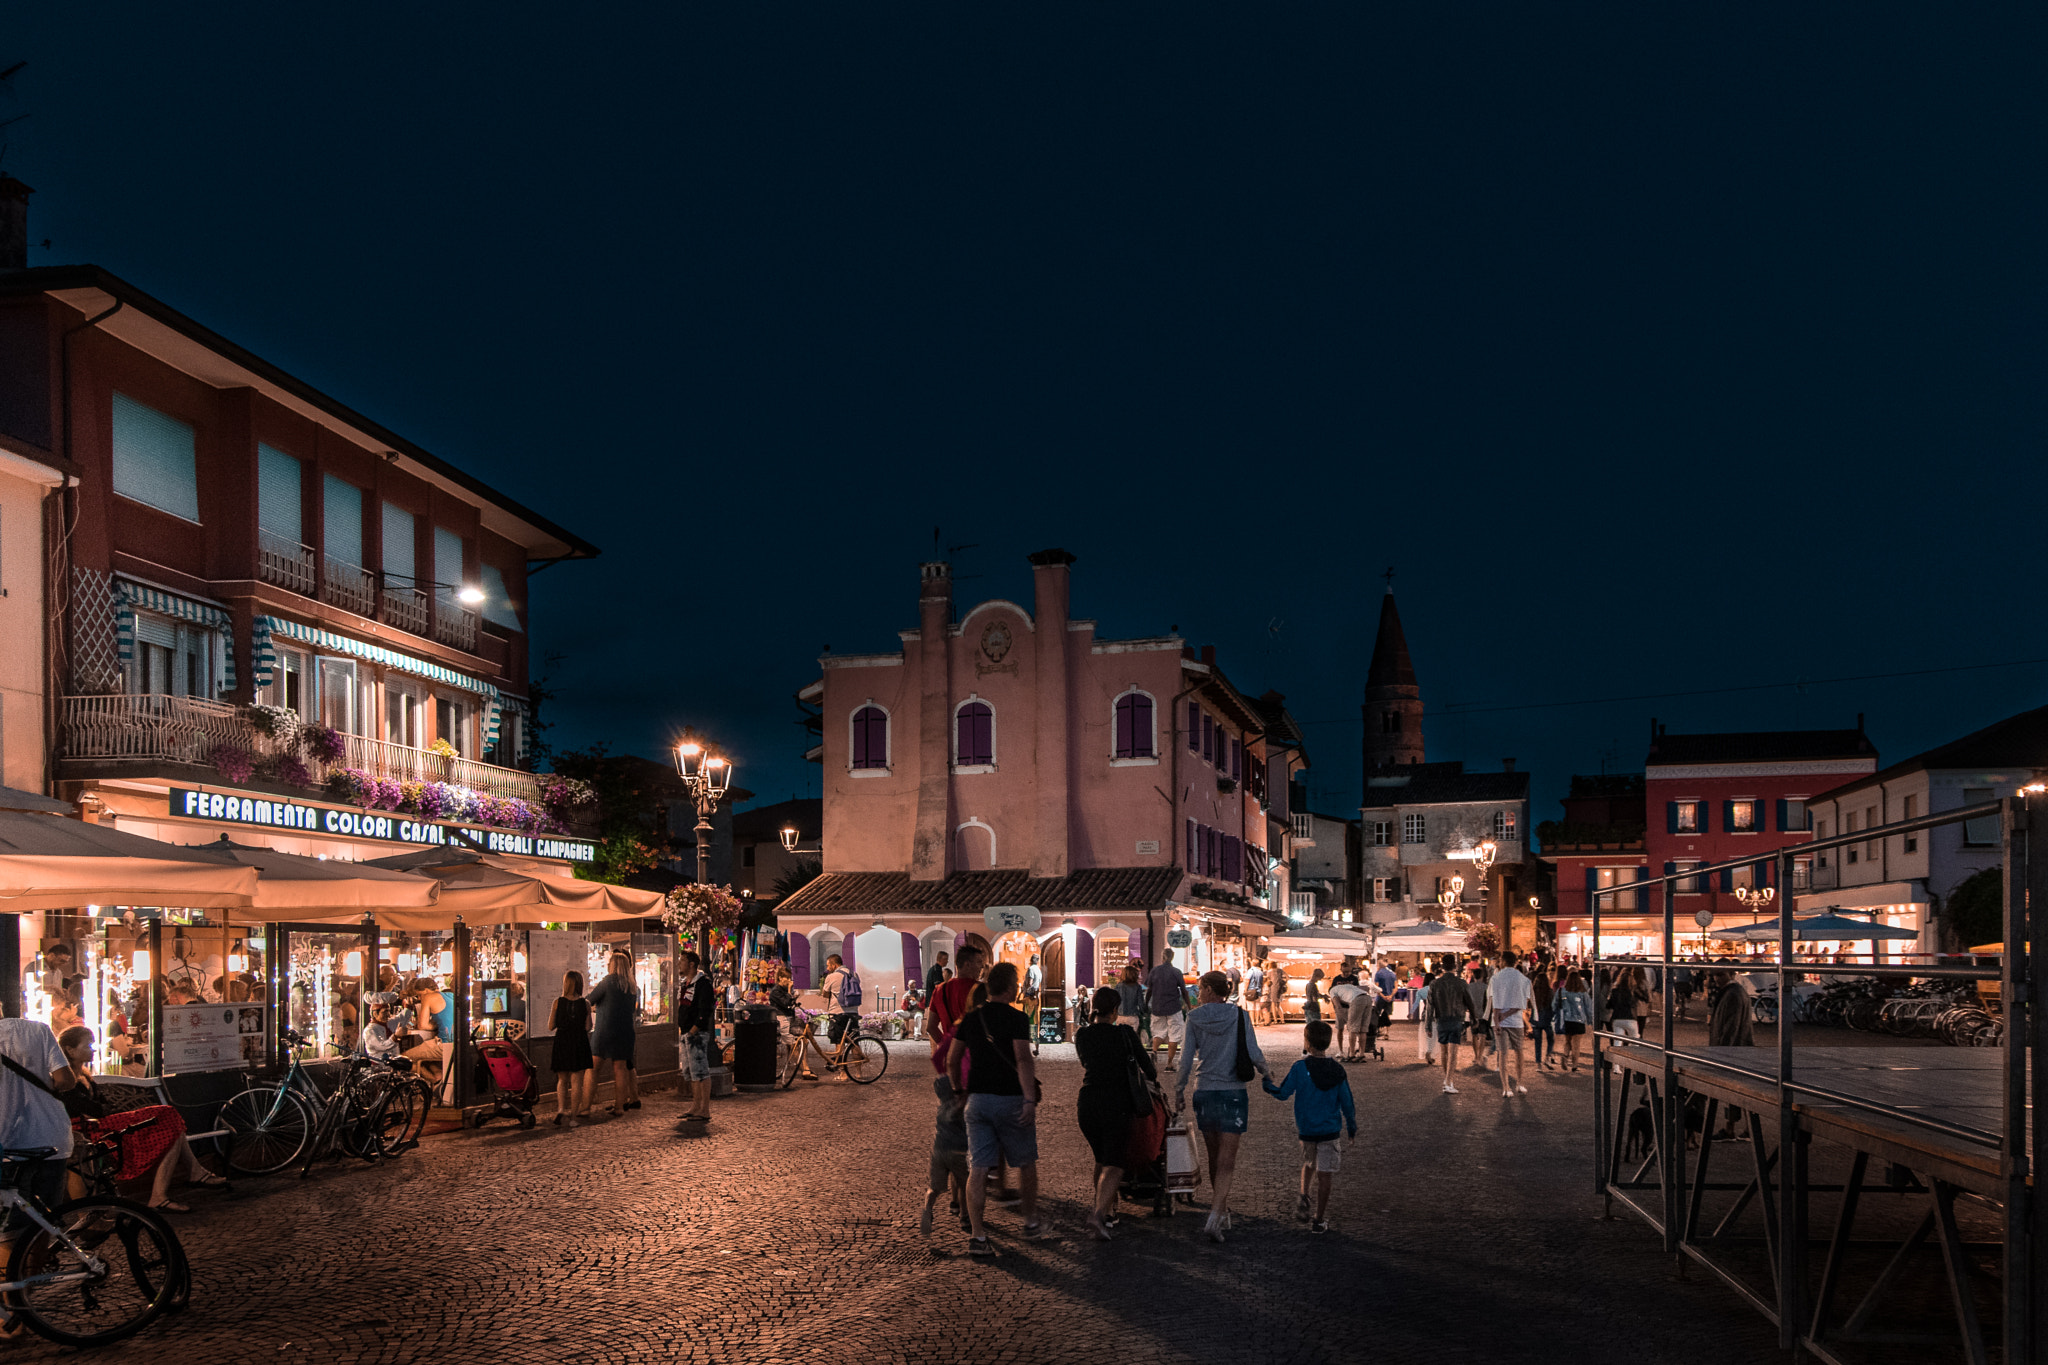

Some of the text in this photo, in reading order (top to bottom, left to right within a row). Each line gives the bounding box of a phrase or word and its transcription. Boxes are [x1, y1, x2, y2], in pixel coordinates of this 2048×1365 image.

[185, 791, 317, 829] FERRAMENTA
[326, 810, 393, 839] COLORI
[489, 832, 532, 854] REGALI
[537, 839, 594, 861] CAMPAGNER
